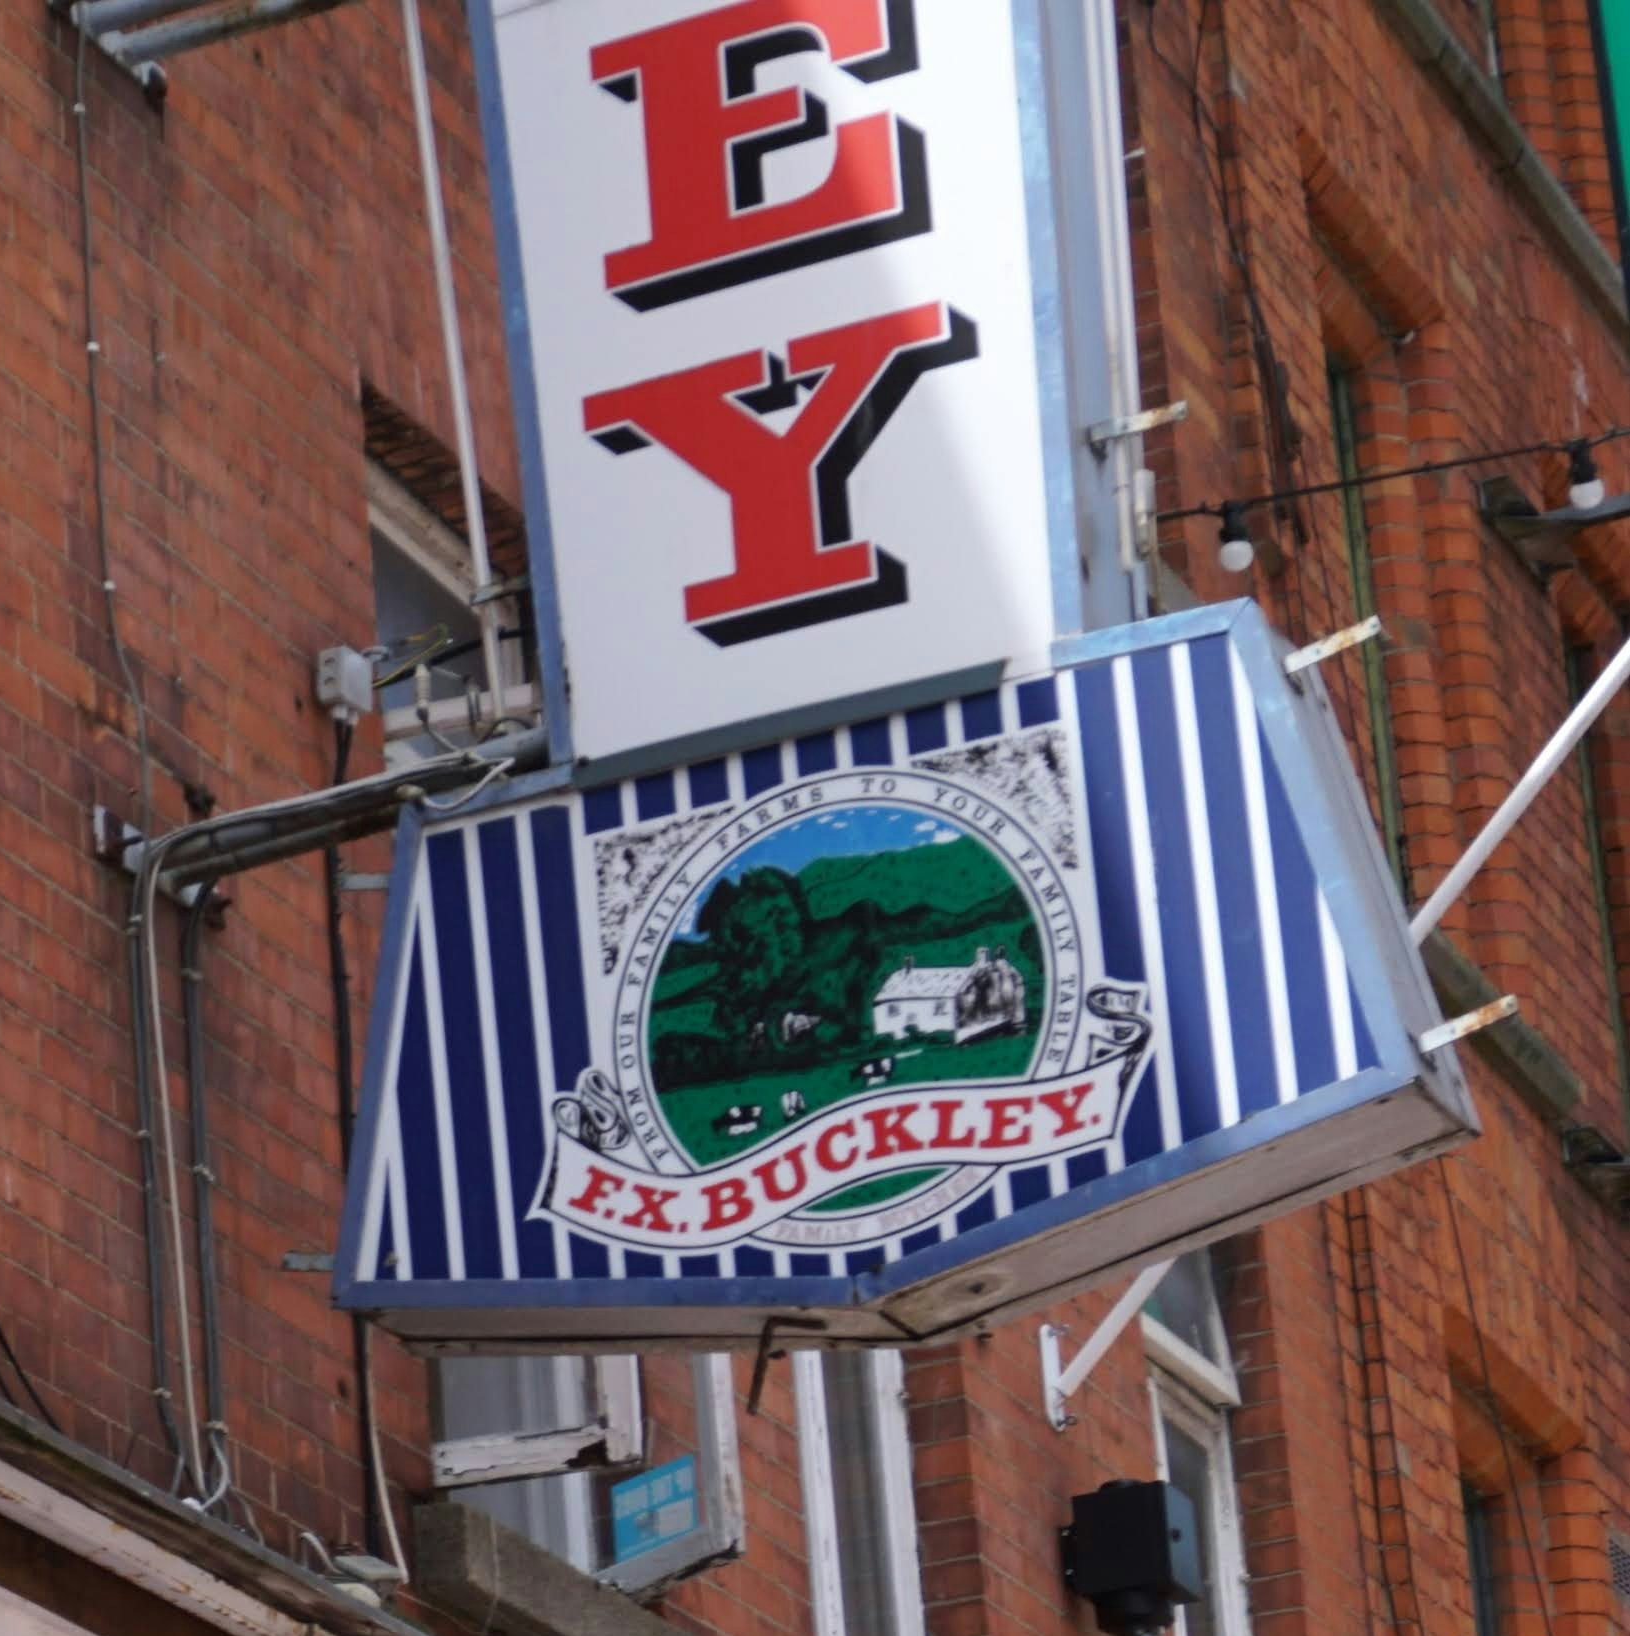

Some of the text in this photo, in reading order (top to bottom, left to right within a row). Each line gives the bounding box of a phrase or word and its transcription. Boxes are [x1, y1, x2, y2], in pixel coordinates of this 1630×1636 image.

[619, 777, 1079, 1162] FROM OUR FAMILY FARMS TO YOUR FAMILY TABLE
